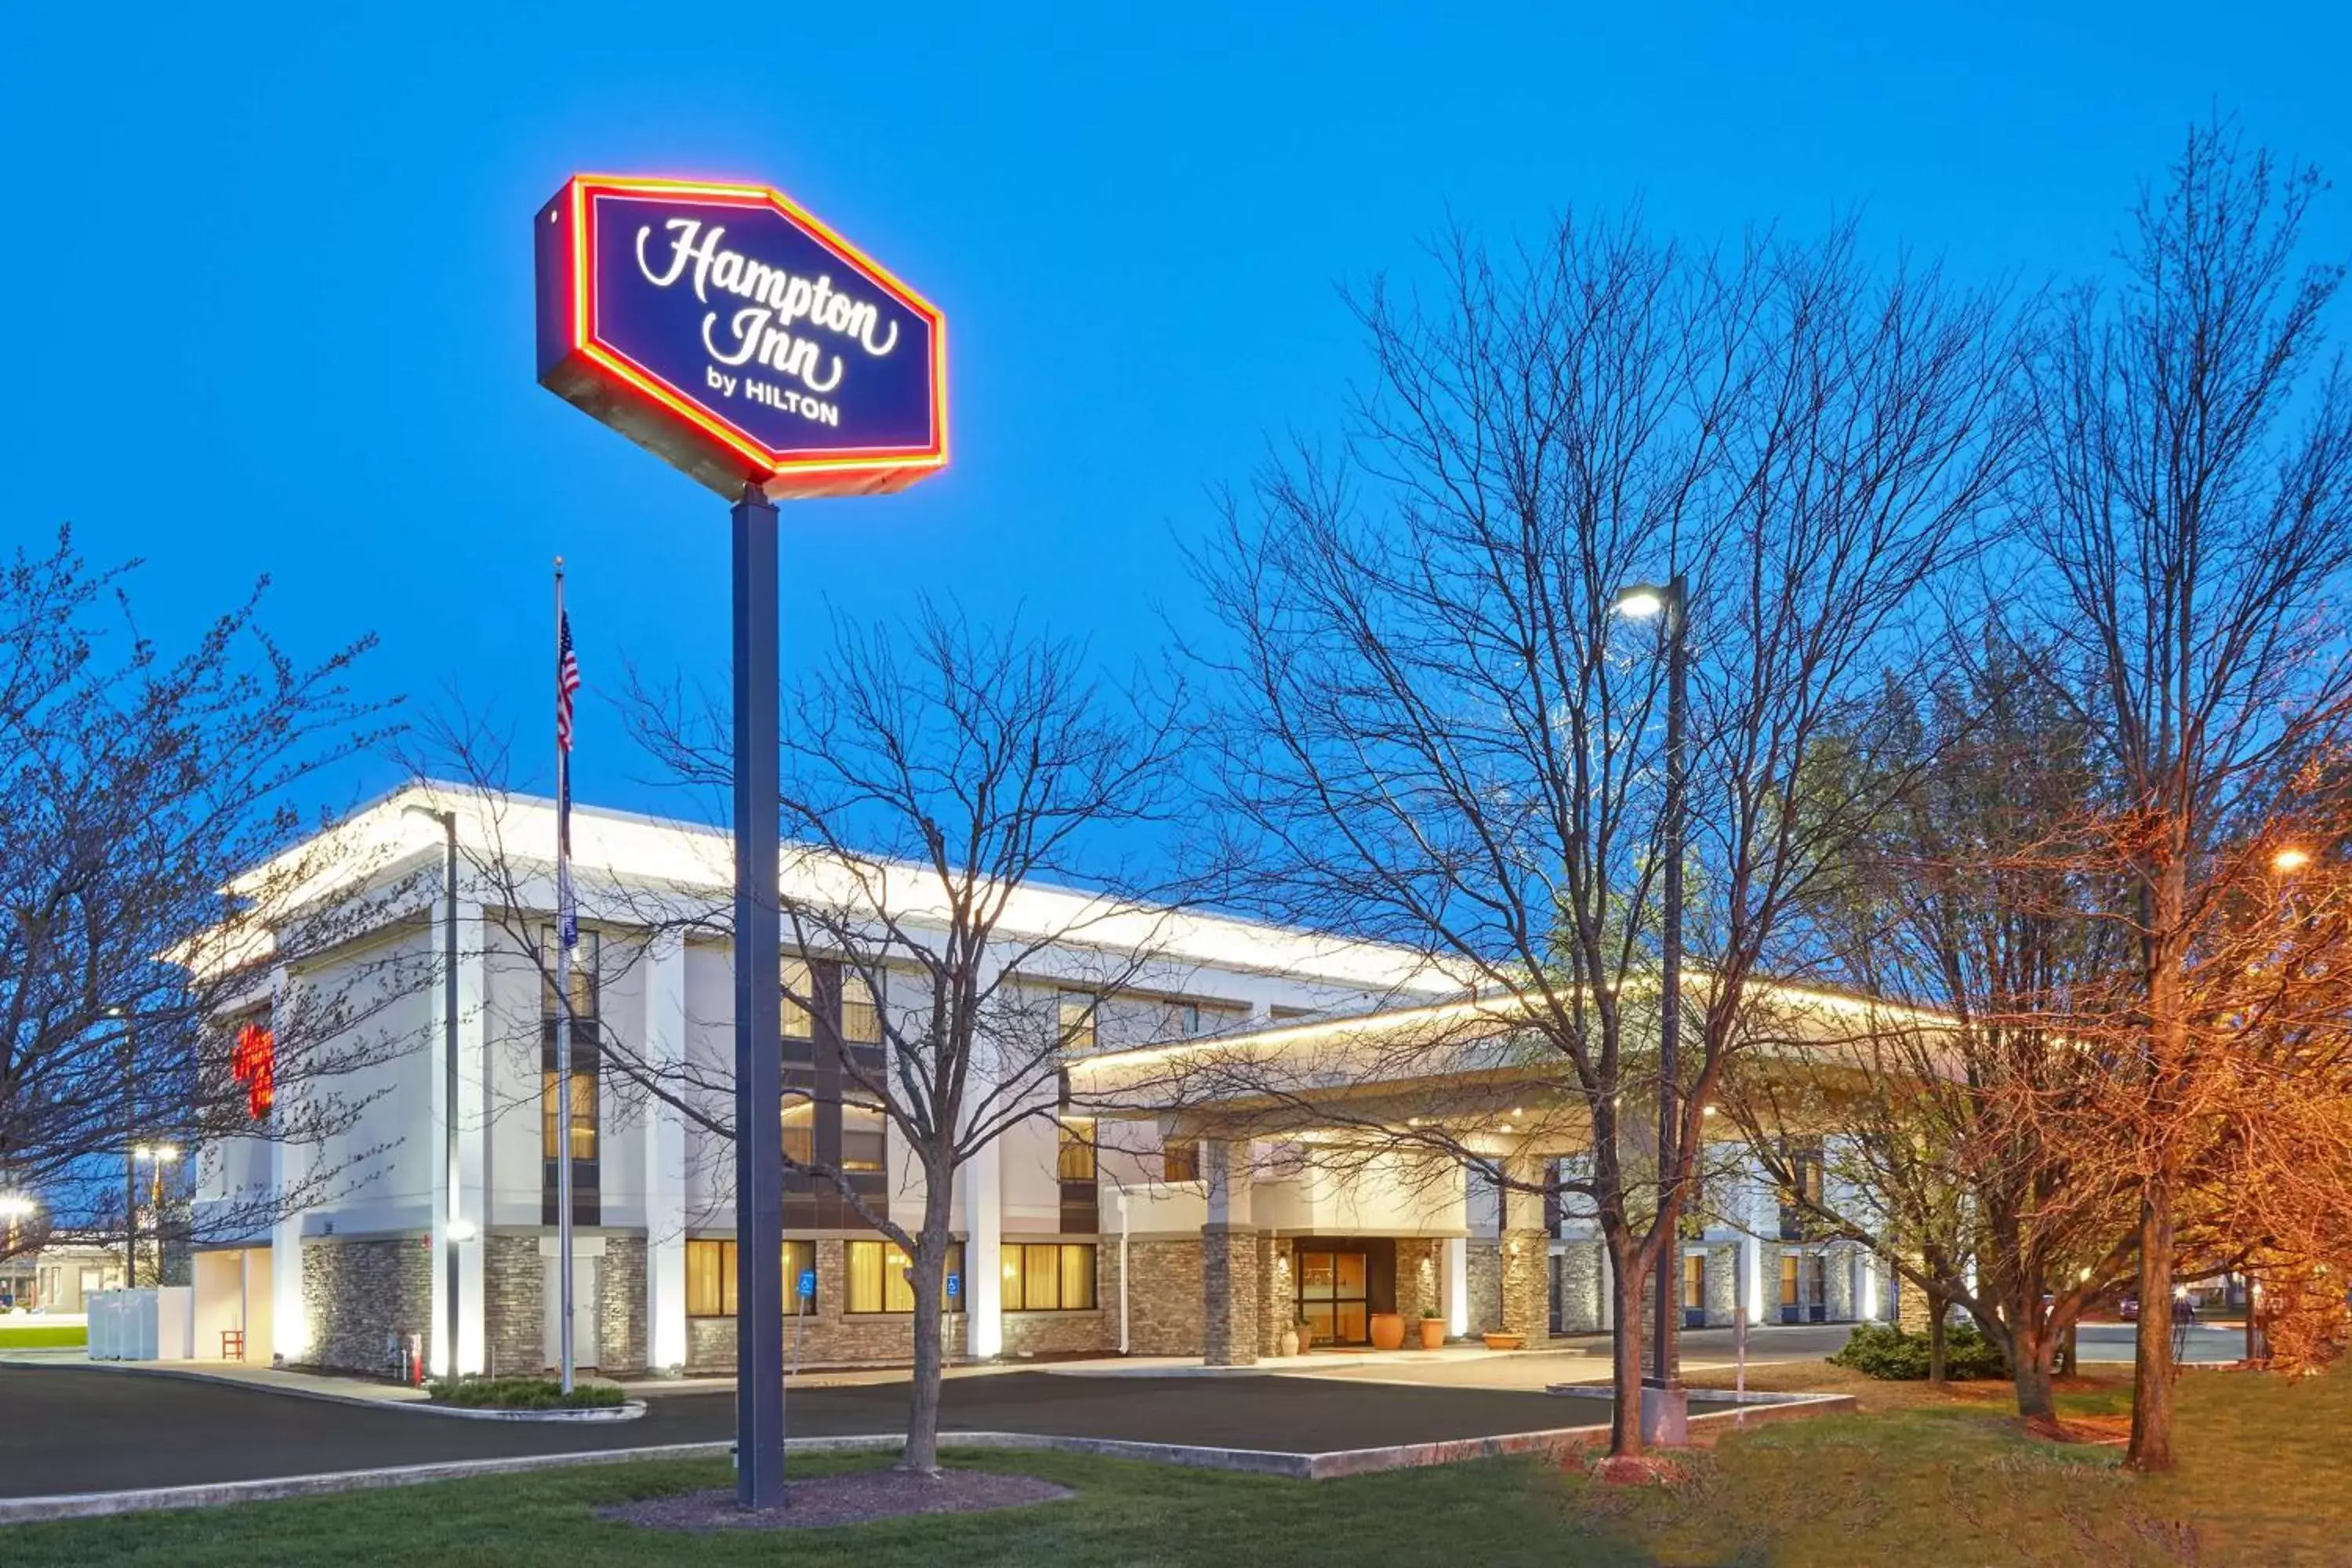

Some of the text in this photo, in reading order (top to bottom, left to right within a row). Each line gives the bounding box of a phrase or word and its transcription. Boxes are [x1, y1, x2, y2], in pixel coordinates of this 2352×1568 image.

[637, 218, 898, 356] Hampton
[702, 307, 843, 393] Inn
[707, 365, 839, 426] by HILTON
